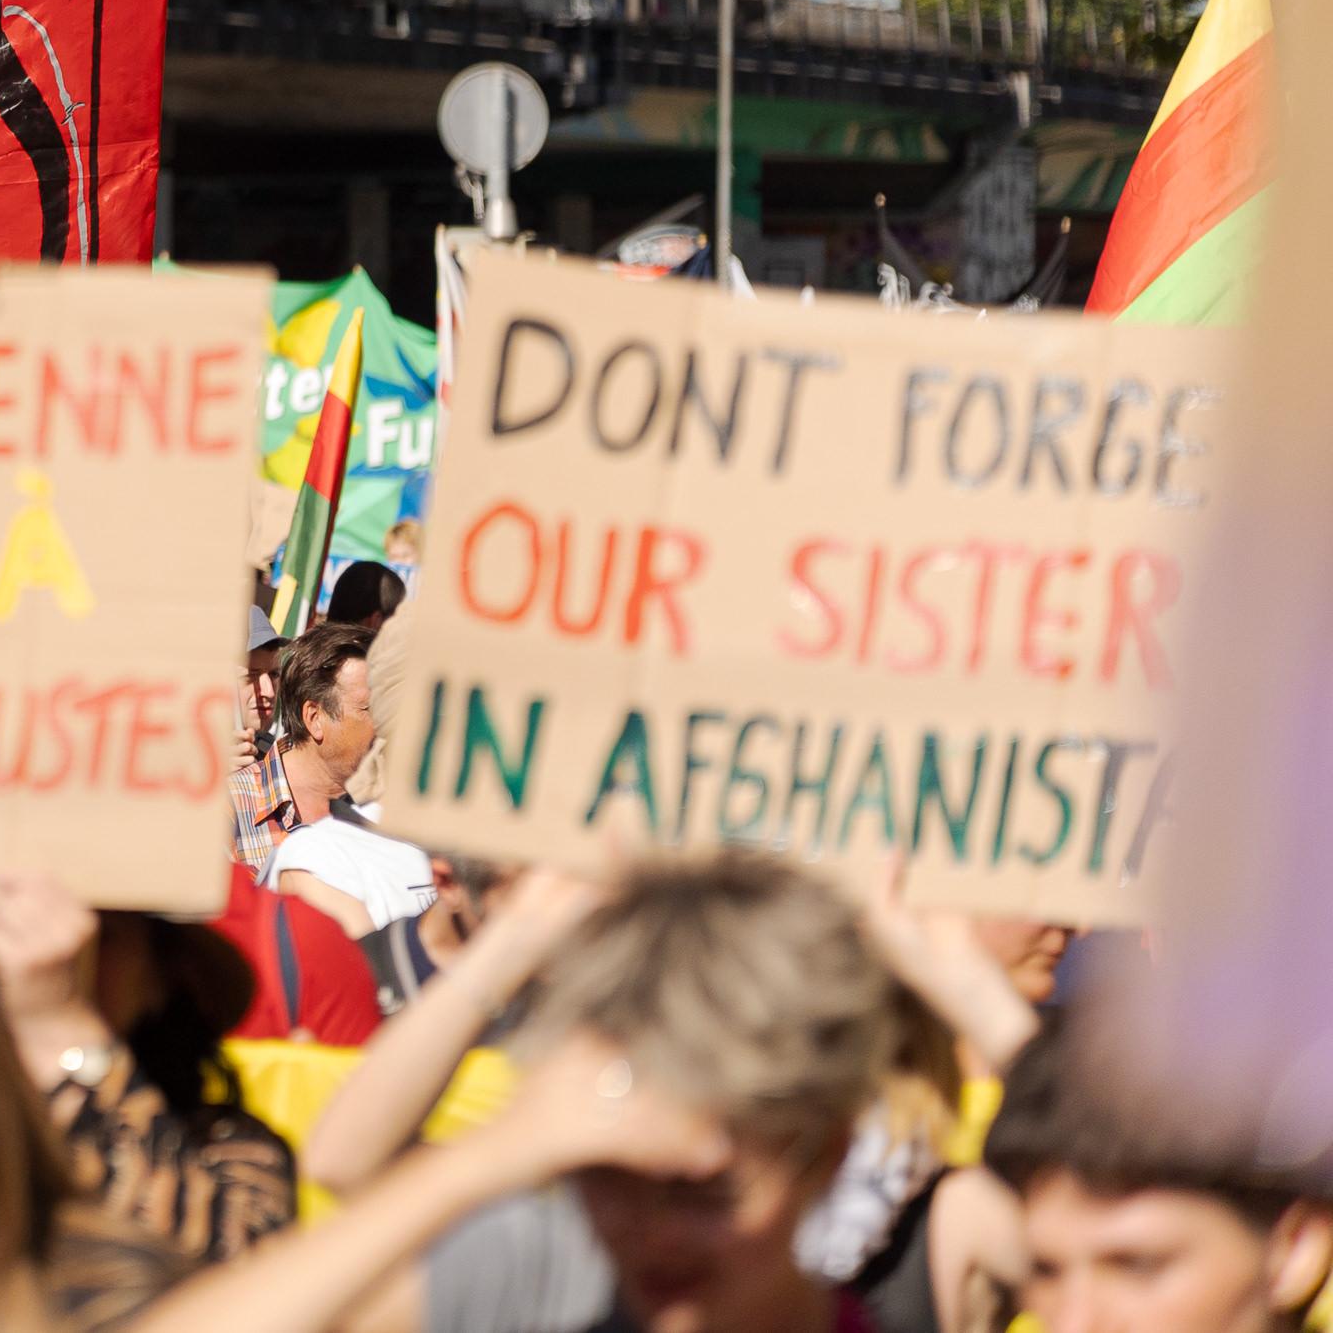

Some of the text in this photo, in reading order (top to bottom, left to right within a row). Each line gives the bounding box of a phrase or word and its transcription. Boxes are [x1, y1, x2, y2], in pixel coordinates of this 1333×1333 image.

[489, 318, 840, 477] DONT
[457, 498, 711, 656] OUR
[415, 678, 545, 809] IN
